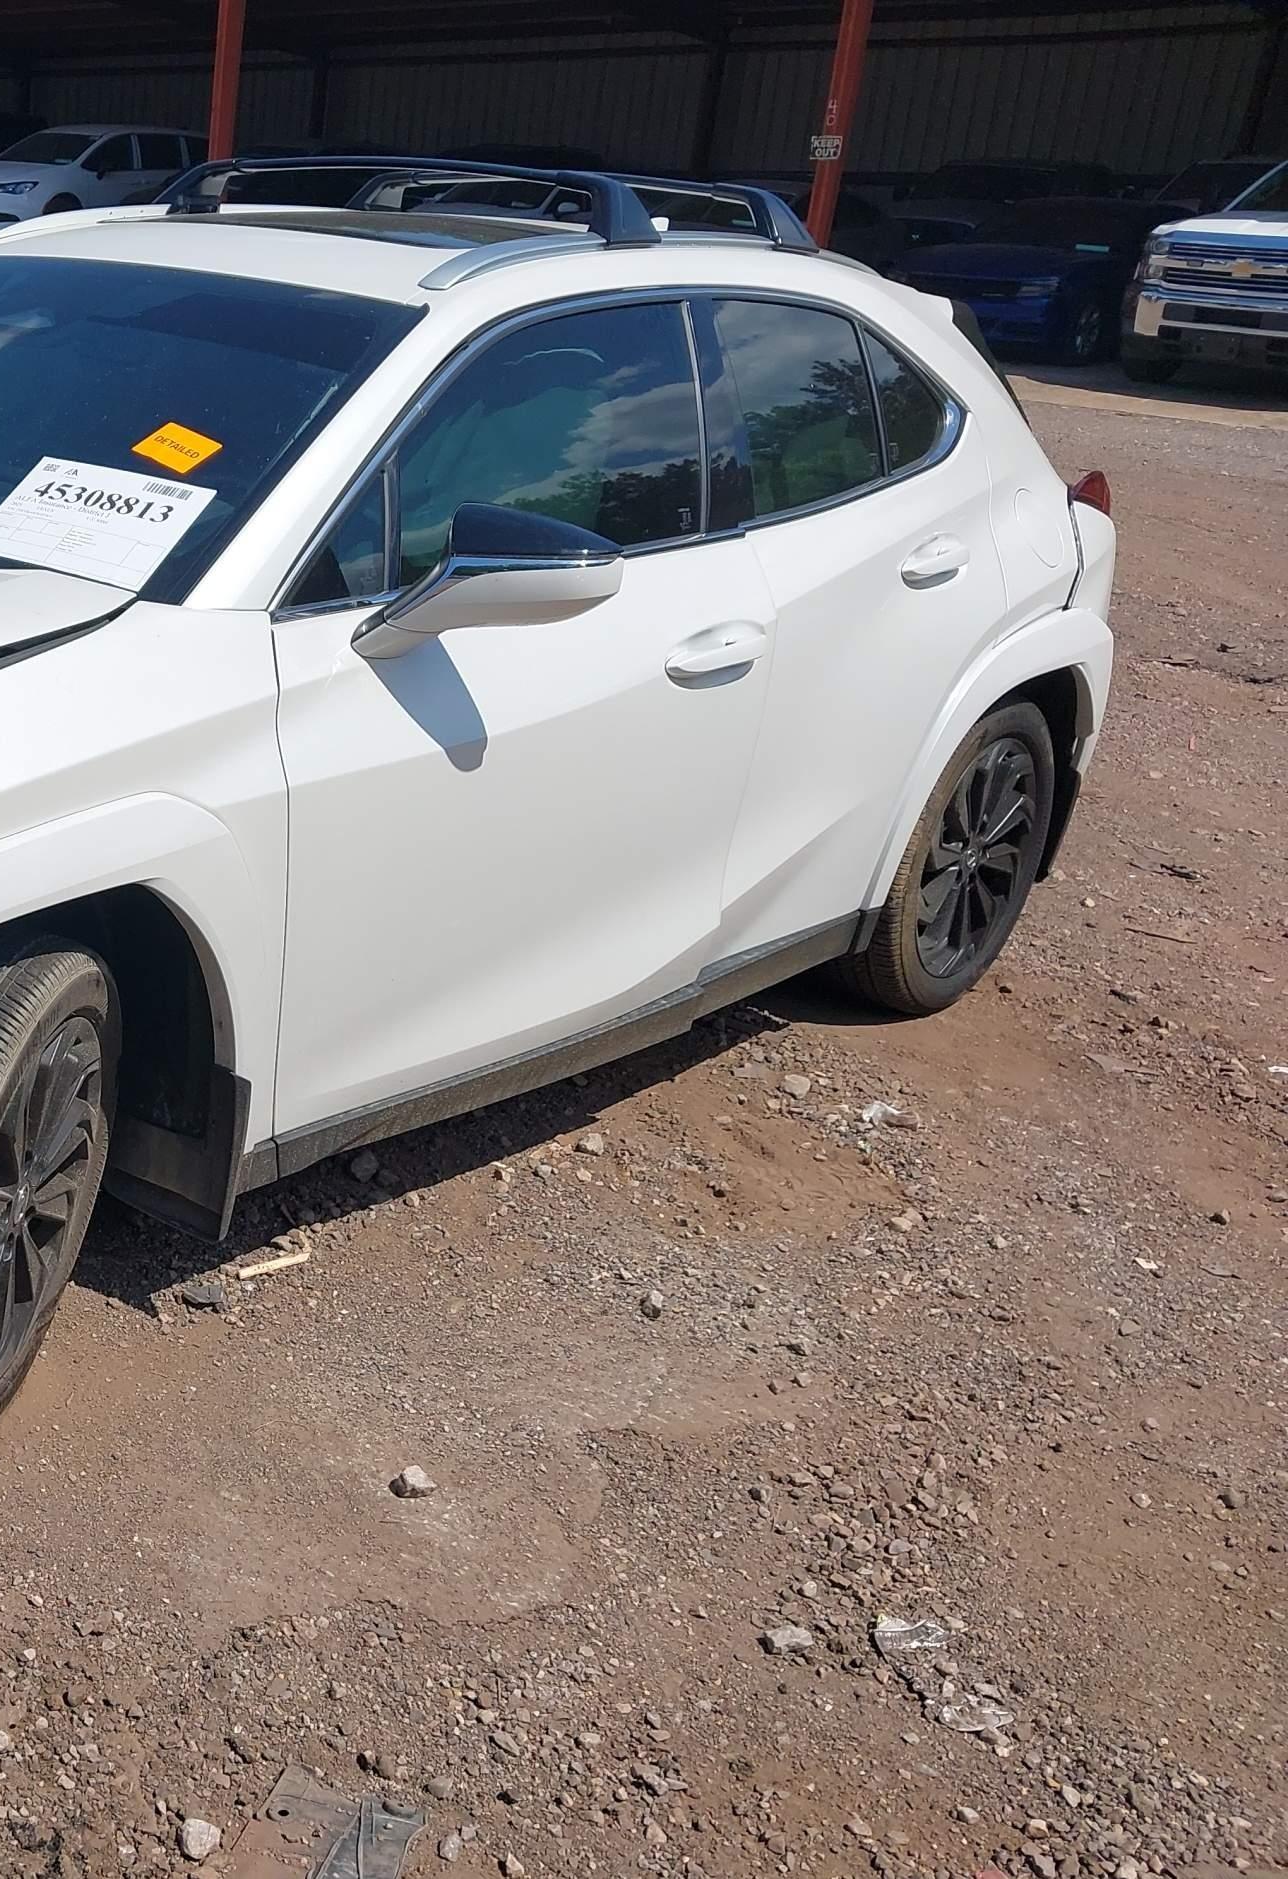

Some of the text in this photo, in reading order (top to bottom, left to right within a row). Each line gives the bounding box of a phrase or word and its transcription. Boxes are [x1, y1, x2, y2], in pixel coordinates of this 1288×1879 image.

[814, 139, 840, 148] KEEP
[815, 148, 837, 157] OUT
[154, 434, 200, 460] DETAILED
[33, 480, 174, 523] 45308813
